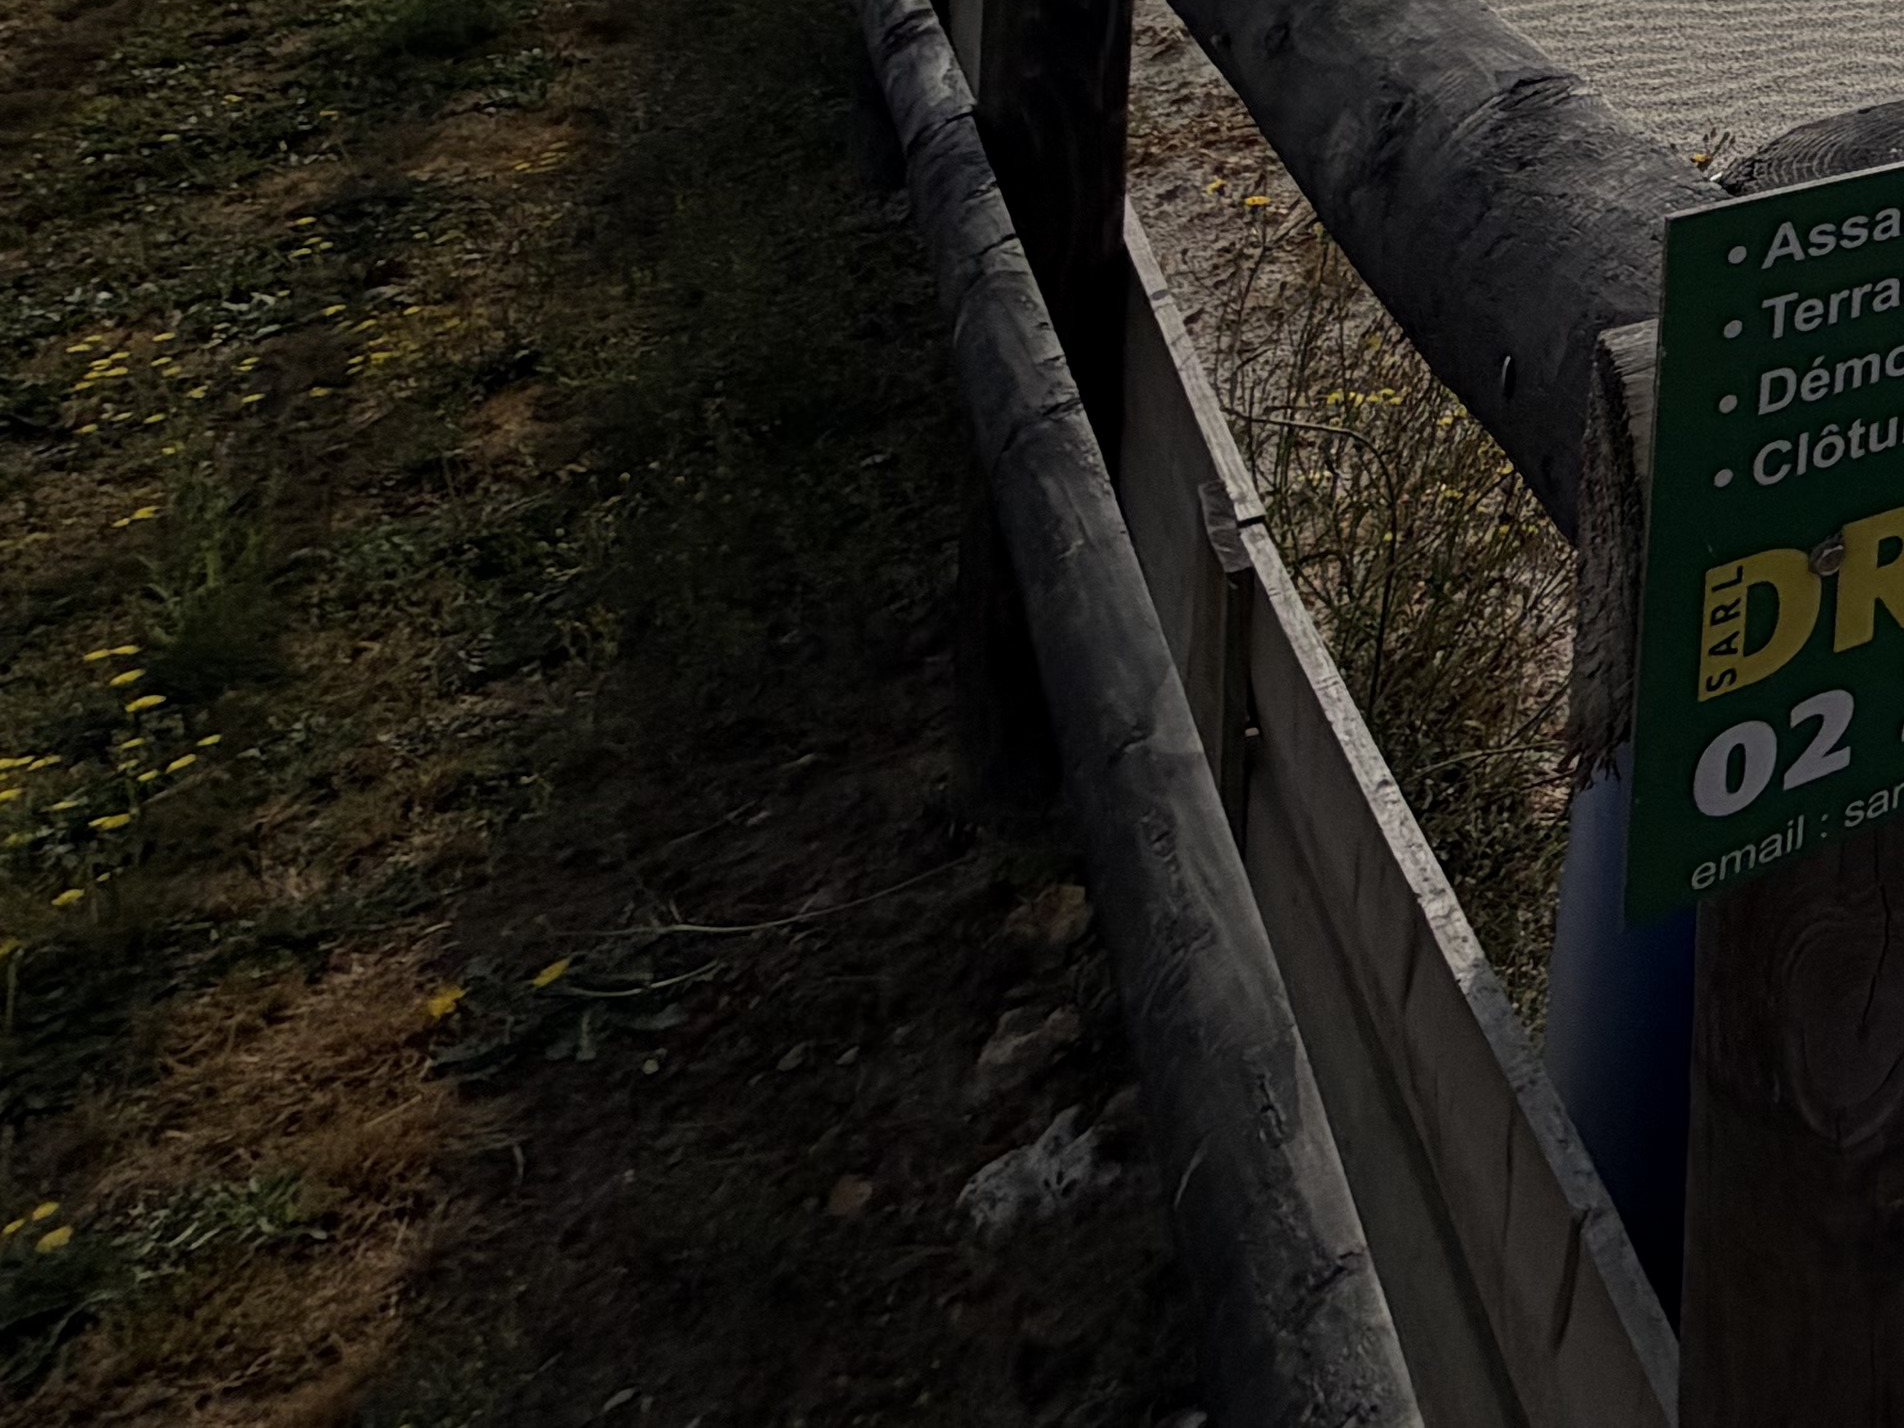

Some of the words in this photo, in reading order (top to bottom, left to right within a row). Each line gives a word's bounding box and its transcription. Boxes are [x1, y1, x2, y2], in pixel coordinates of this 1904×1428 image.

[1706, 565, 1744, 693] SARL
[1692, 688, 1856, 818] 02
[1690, 814, 1805, 891] email
